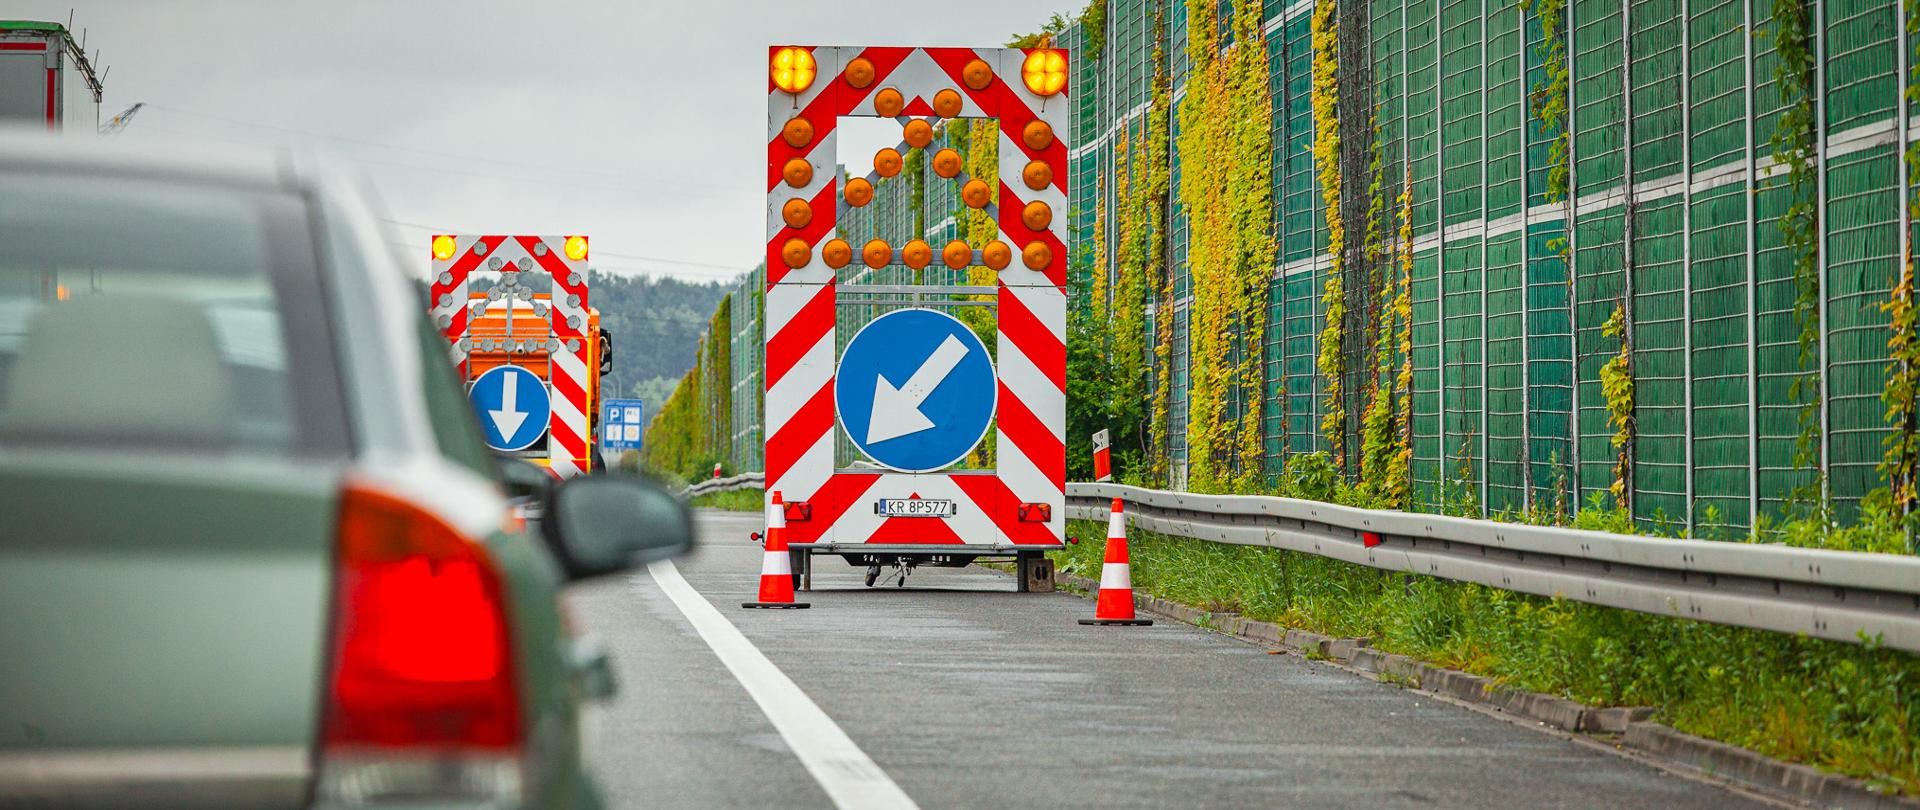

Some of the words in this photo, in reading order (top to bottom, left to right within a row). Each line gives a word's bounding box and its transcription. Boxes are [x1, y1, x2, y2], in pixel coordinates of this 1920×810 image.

[610, 407, 620, 421] P
[888, 501, 904, 513] KR
[909, 501, 947, 513] 8P577
